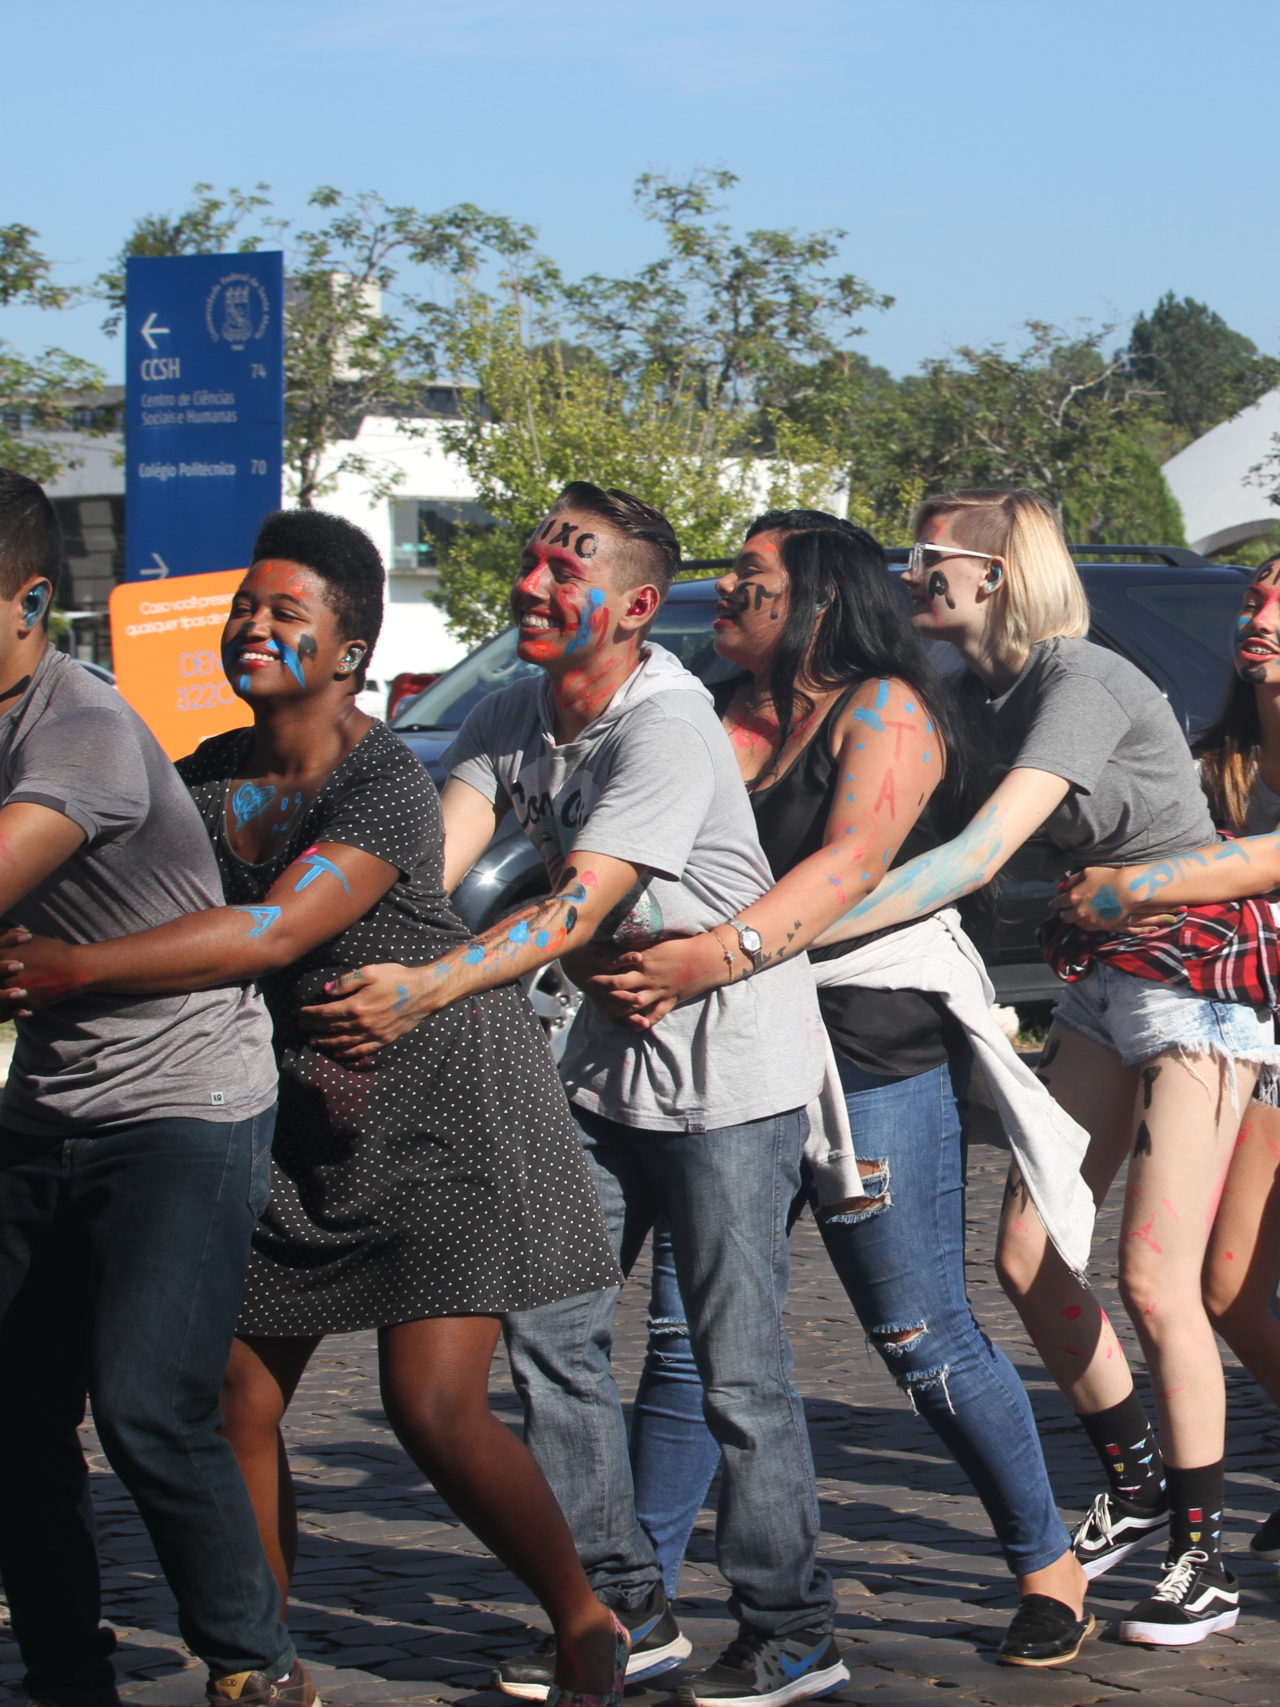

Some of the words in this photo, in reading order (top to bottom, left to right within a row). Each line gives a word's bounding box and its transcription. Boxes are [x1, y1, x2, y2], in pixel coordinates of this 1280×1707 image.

[141, 357, 181, 382] CCSH
[251, 363, 267, 379] 74
[141, 393, 176, 409] Centro
[178, 392, 191, 407] de
[193, 389, 235, 406] Ciências
[141, 409, 176, 426] Sociais
[186, 409, 238, 424] Humanas
[138, 461, 177, 482] Colégio
[178, 460, 237, 478] Politécnico
[251, 459, 267, 476] 70
[139, 601, 171, 616] Caso
[171, 595, 199, 612] você
[125, 619, 177, 637] quaisquer
